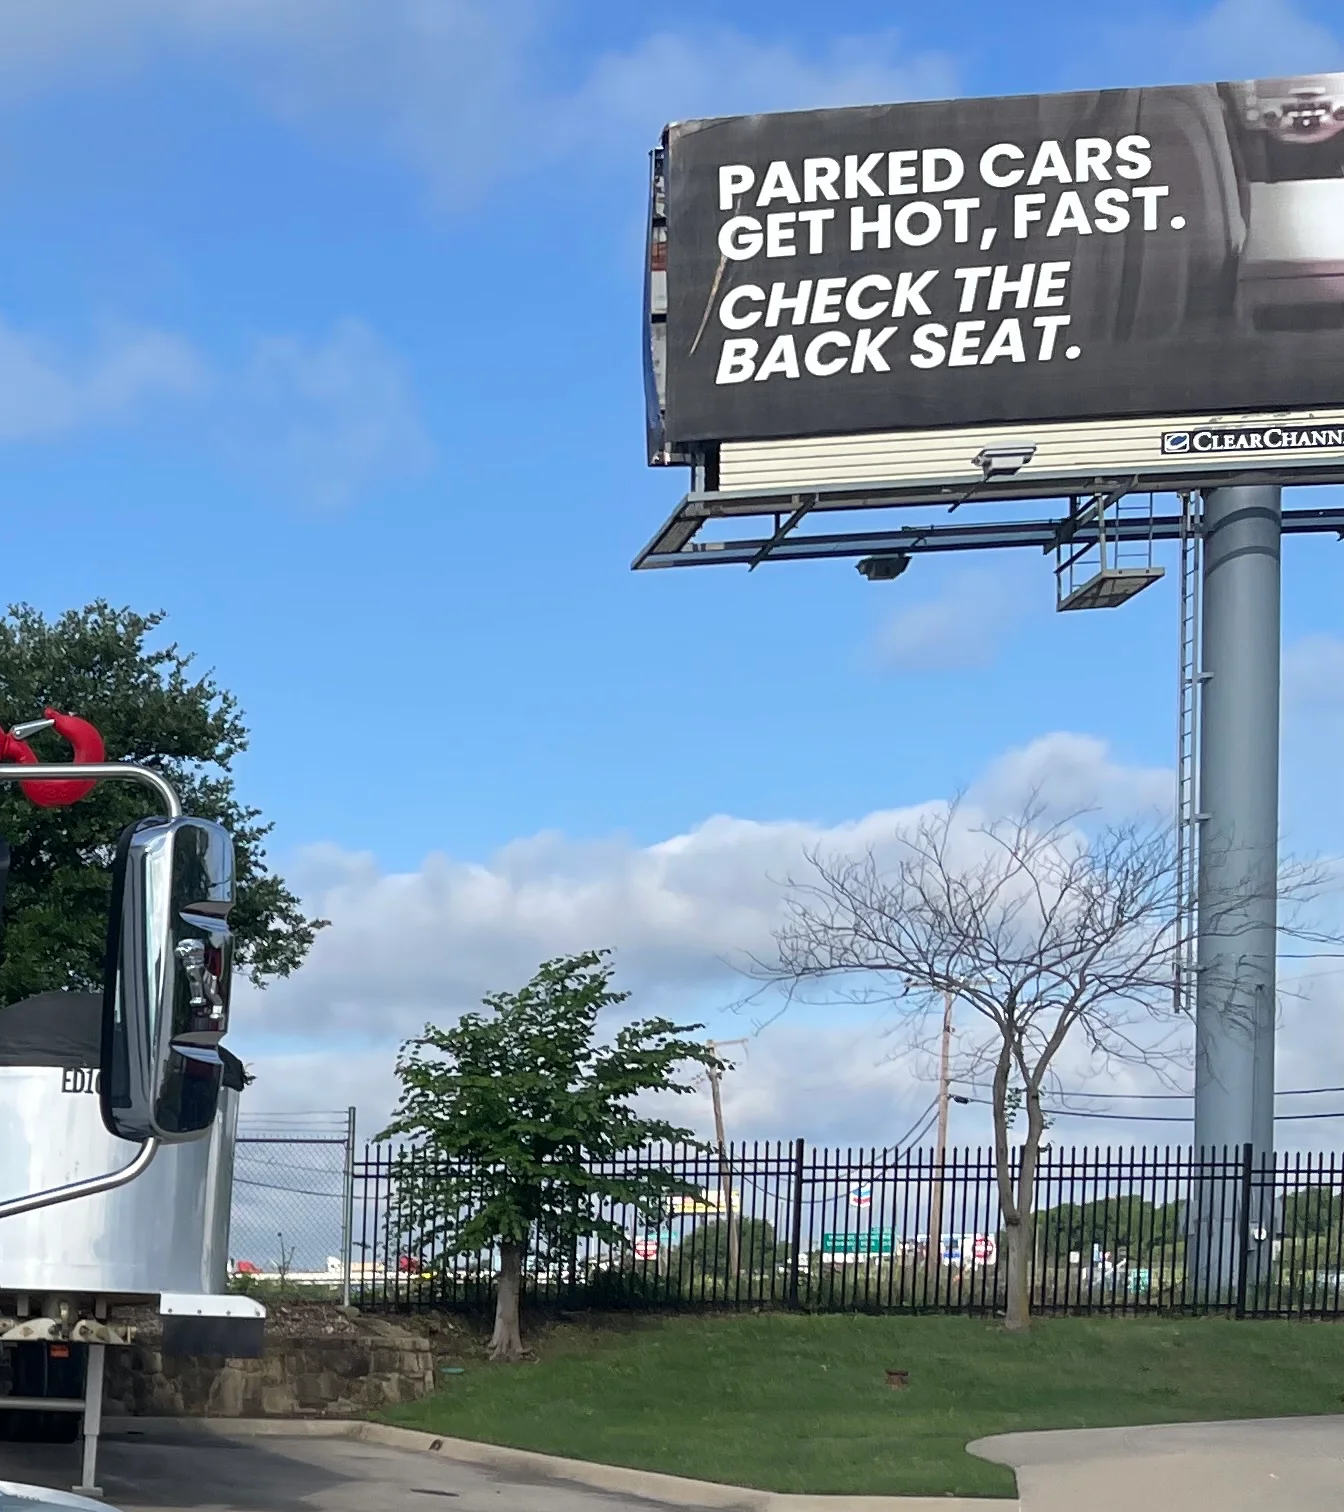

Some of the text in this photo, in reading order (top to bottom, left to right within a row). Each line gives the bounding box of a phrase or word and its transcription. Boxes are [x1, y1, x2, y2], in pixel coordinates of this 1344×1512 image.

[718, 135, 1152, 210] PARKED CARS
[718, 185, 1186, 261] GET HOT, FAST.
[718, 260, 1071, 330] CHECK THE
[715, 314, 1082, 385] BACK SEAT.
